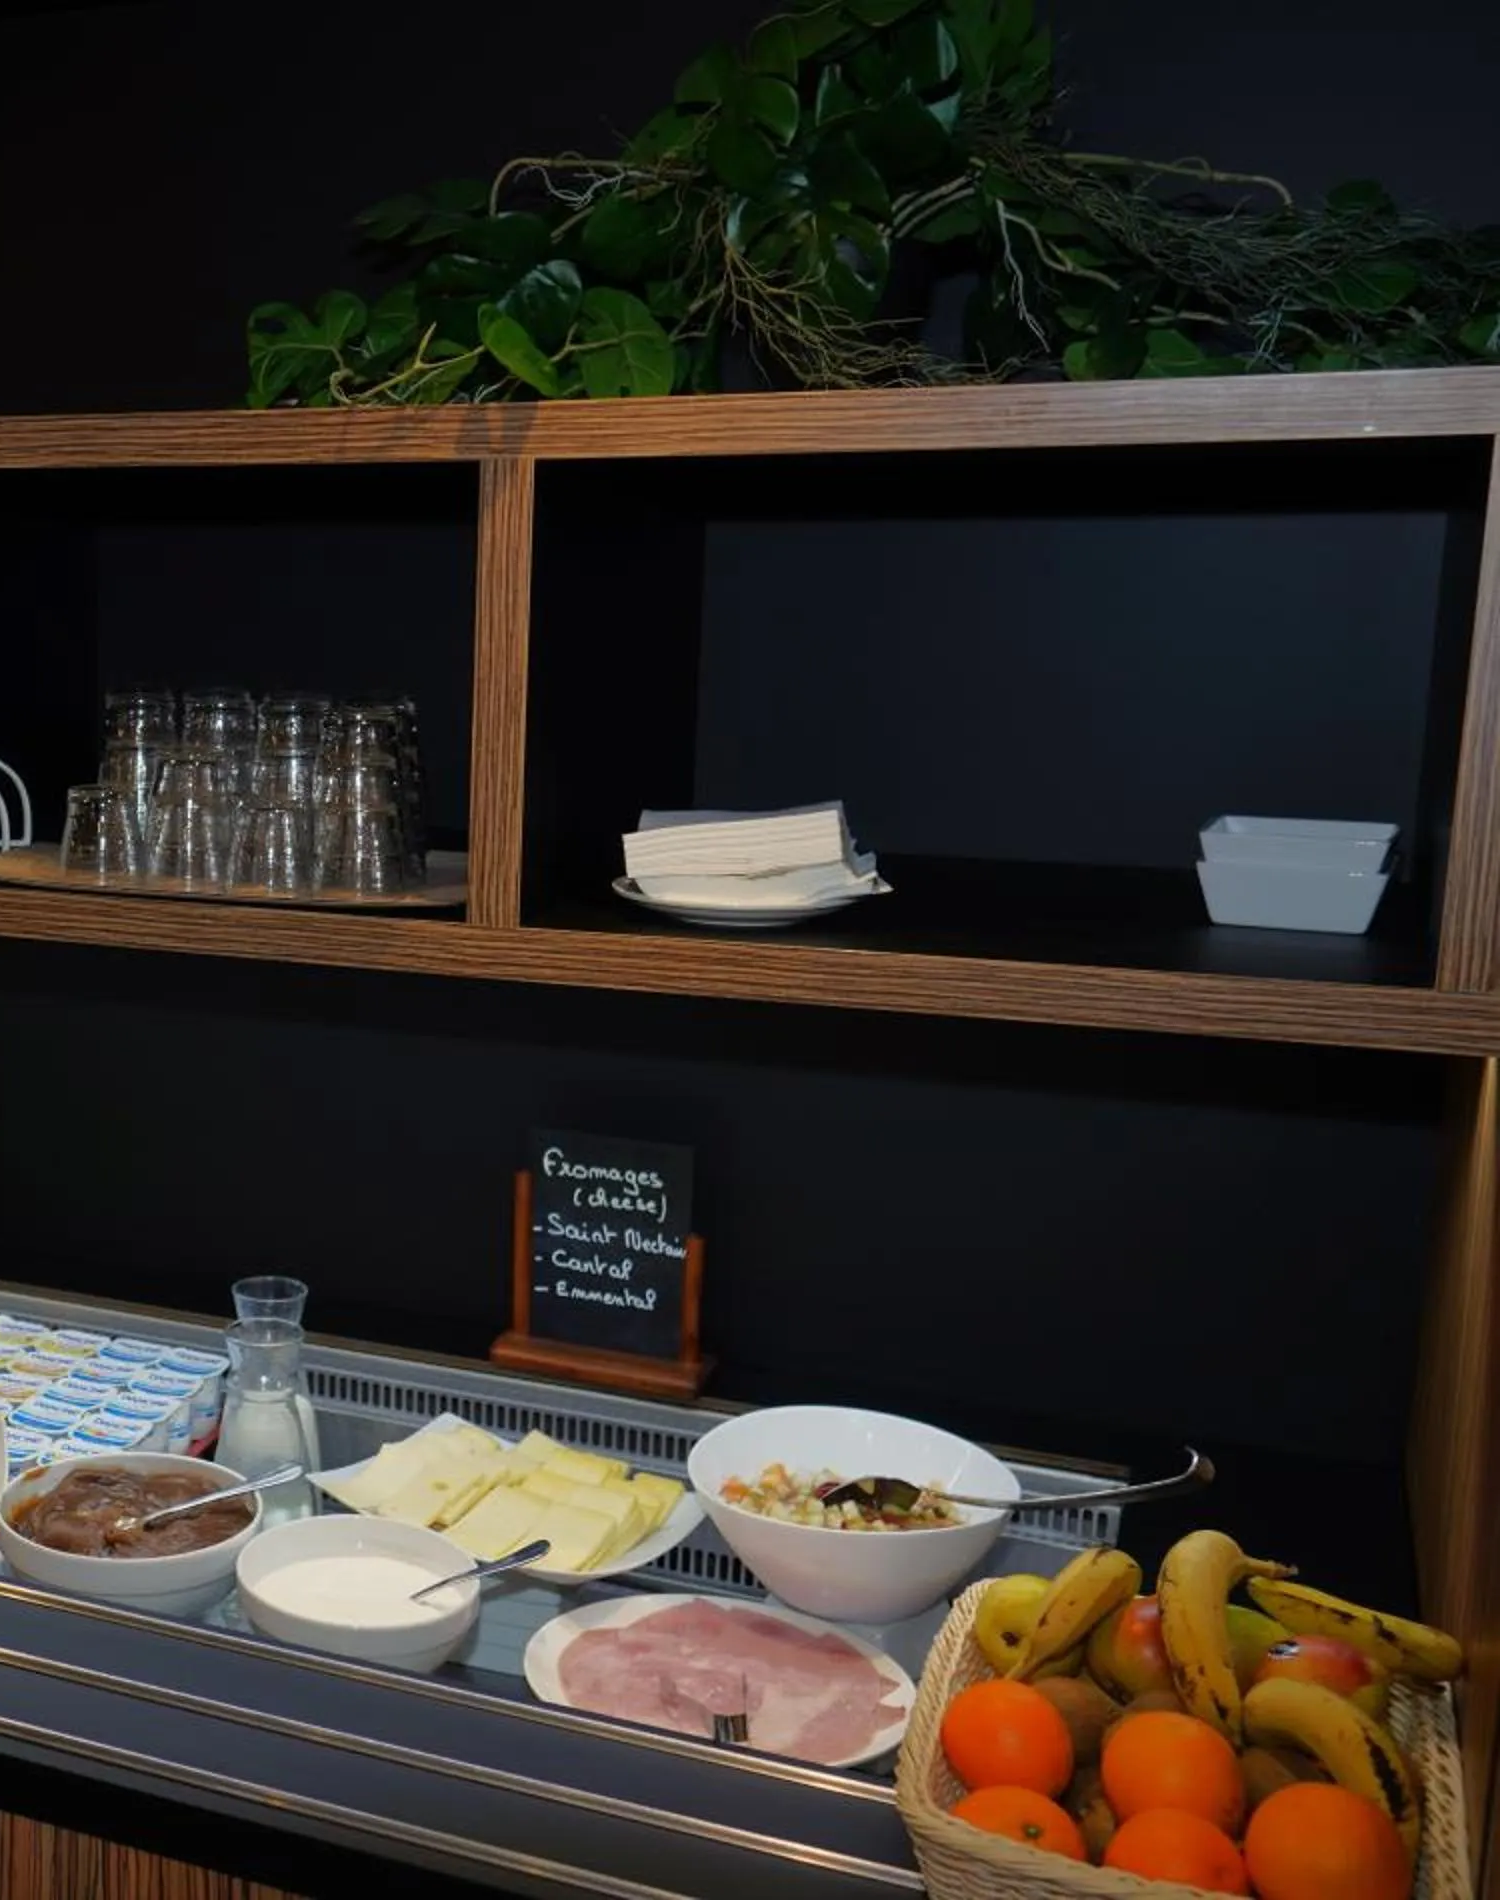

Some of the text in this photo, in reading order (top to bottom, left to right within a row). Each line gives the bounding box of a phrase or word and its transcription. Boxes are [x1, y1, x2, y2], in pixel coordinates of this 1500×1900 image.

[543, 1147, 664, 1196] Fromages
[547, 1212, 618, 1244] Saint
[551, 1249, 634, 1281] Cantal
[555, 1280, 657, 1311] Emmental
